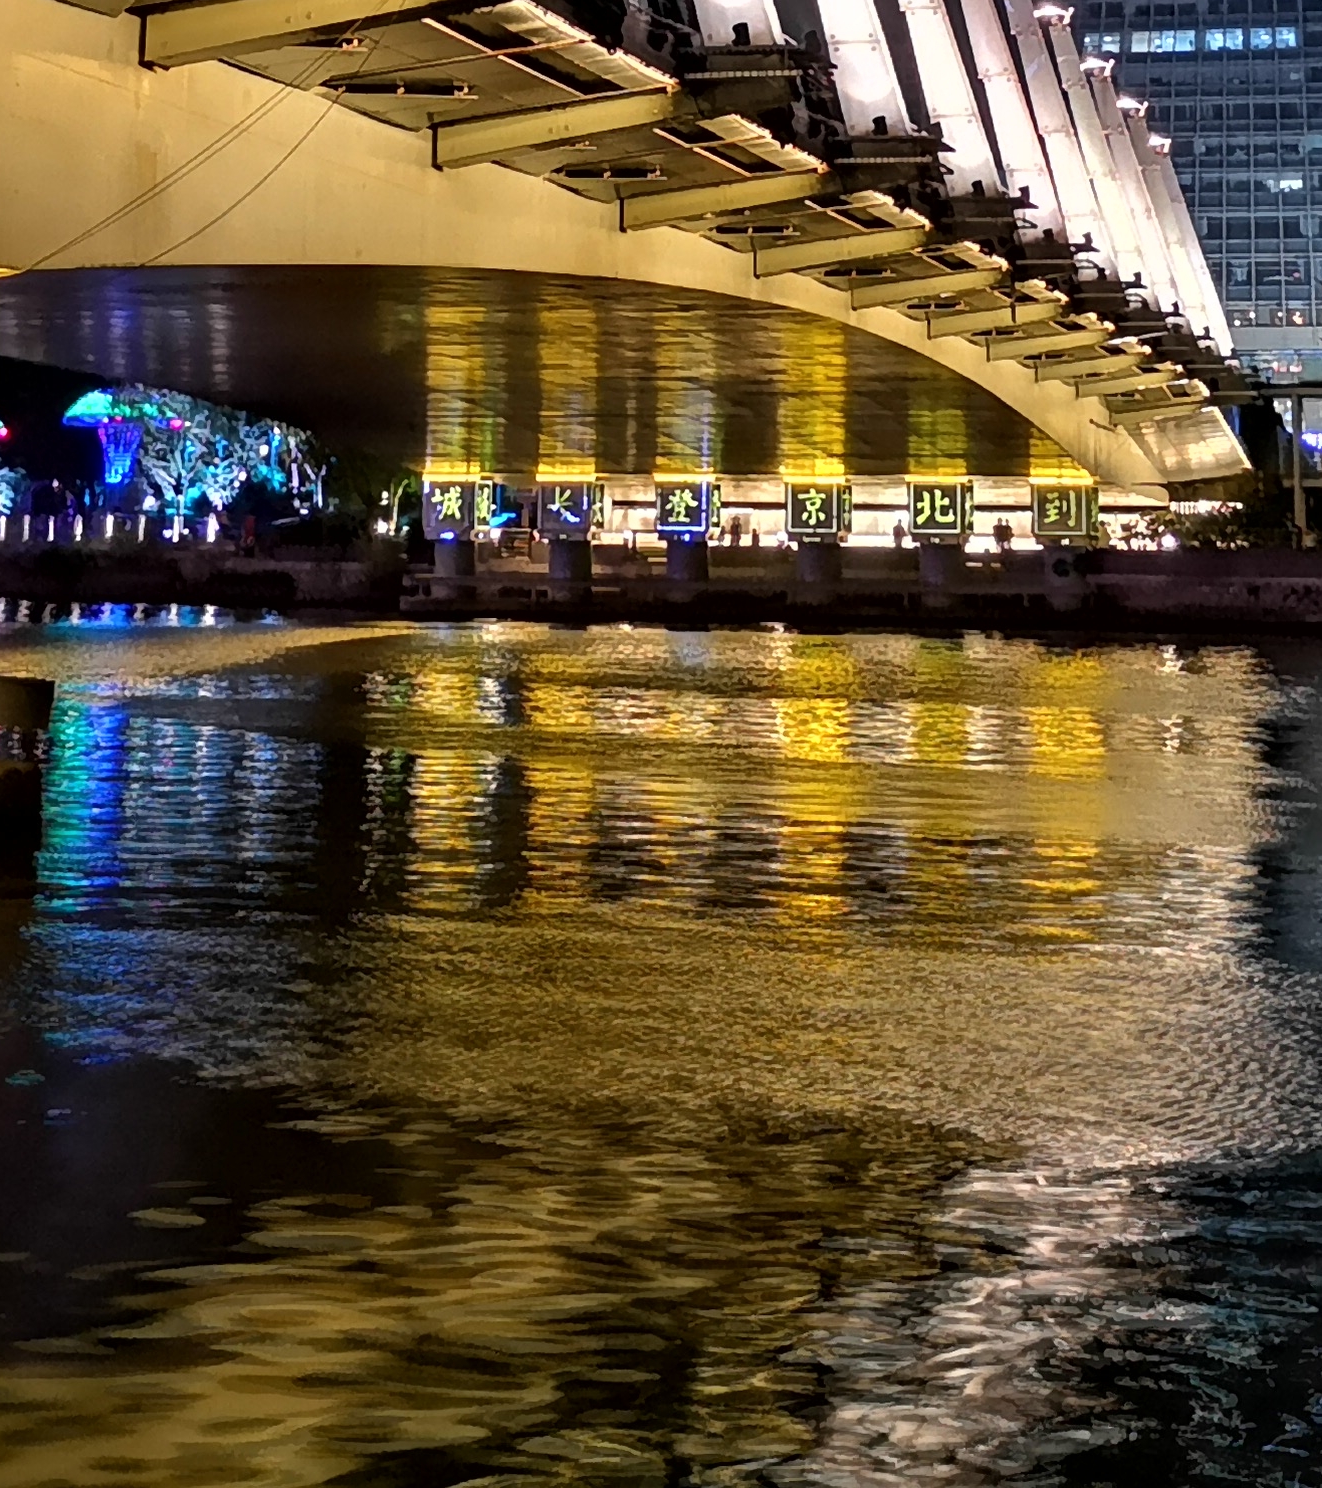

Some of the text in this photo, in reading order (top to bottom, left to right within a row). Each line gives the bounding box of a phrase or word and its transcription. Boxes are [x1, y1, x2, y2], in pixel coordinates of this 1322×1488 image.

[431, 486, 462, 521] 城
[547, 486, 580, 523] 长
[665, 489, 699, 523] 登
[797, 488, 826, 526] 京
[916, 489, 955, 525] 北
[1044, 490, 1076, 528] 到
